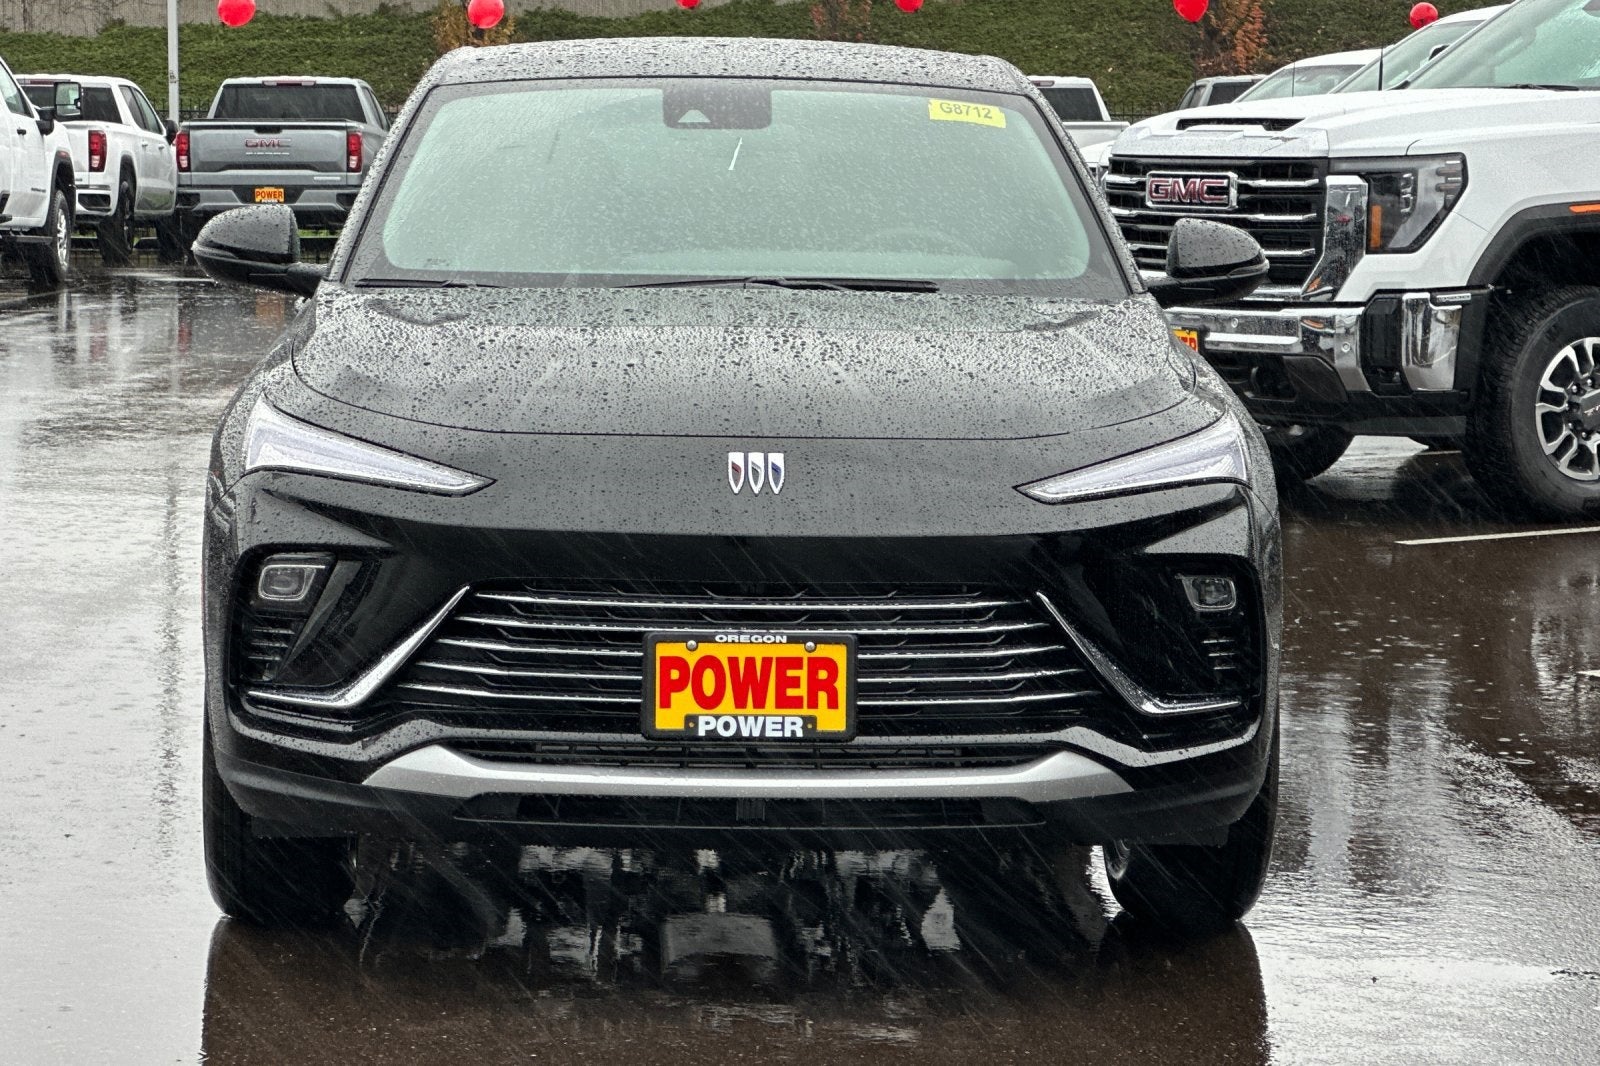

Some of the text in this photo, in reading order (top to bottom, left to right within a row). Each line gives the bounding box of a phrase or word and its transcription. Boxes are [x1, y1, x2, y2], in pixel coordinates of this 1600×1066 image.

[939, 102, 993, 119] G8712
[244, 138, 291, 147] GMC
[255, 190, 283, 199] POWER
[1148, 178, 1229, 204] GMC
[714, 634, 788, 644] OREGON
[659, 655, 839, 710] POWER
[698, 715, 804, 737] POWER
